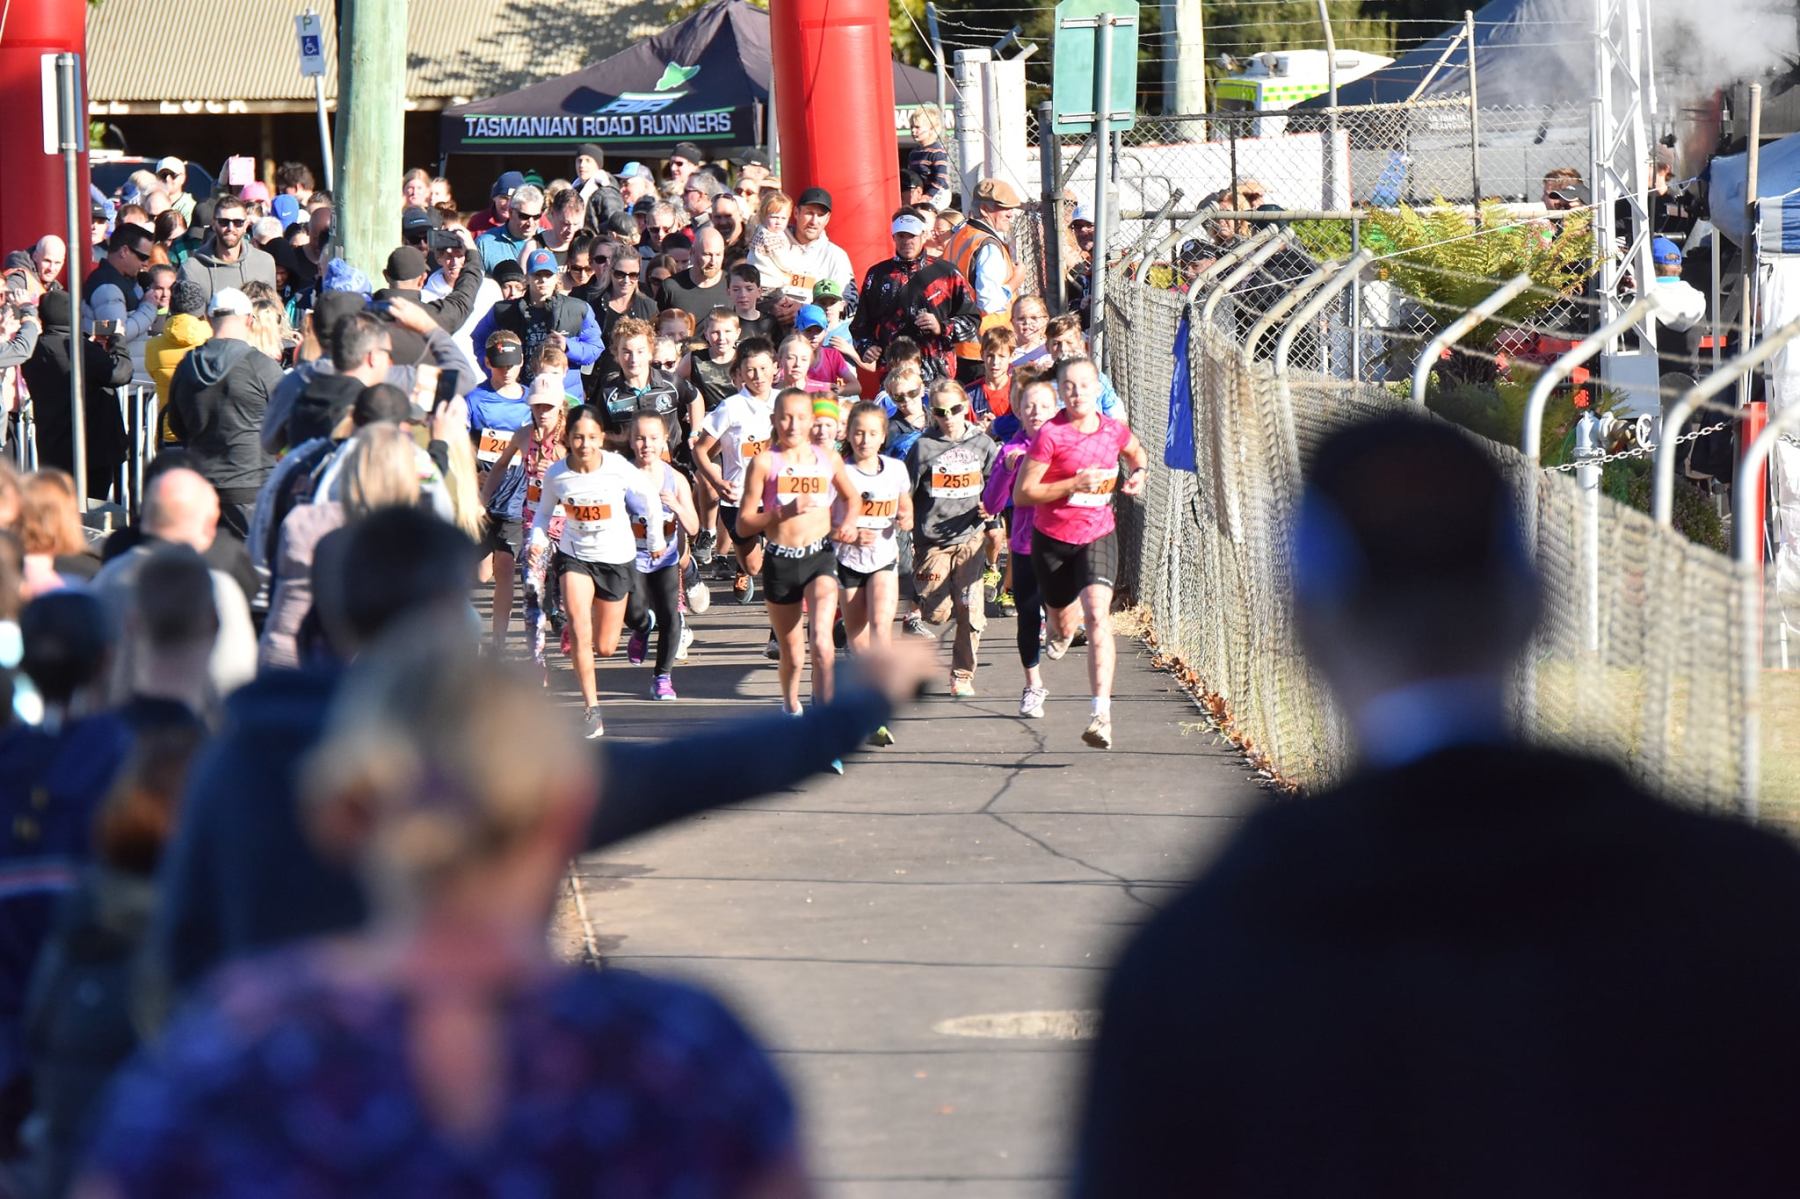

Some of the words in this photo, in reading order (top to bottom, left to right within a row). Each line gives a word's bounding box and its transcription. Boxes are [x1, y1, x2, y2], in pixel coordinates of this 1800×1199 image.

[303, 16, 313, 31] P
[465, 117, 577, 137] TASMANIAN
[582, 116, 635, 136] ROAD
[640, 113, 732, 135] RUNNERS
[791, 274, 806, 288] 81
[790, 477, 820, 494] 269
[943, 474, 970, 489] 255
[573, 506, 601, 522] 243
[864, 501, 892, 517] 270
[776, 545, 806, 559] PRO
